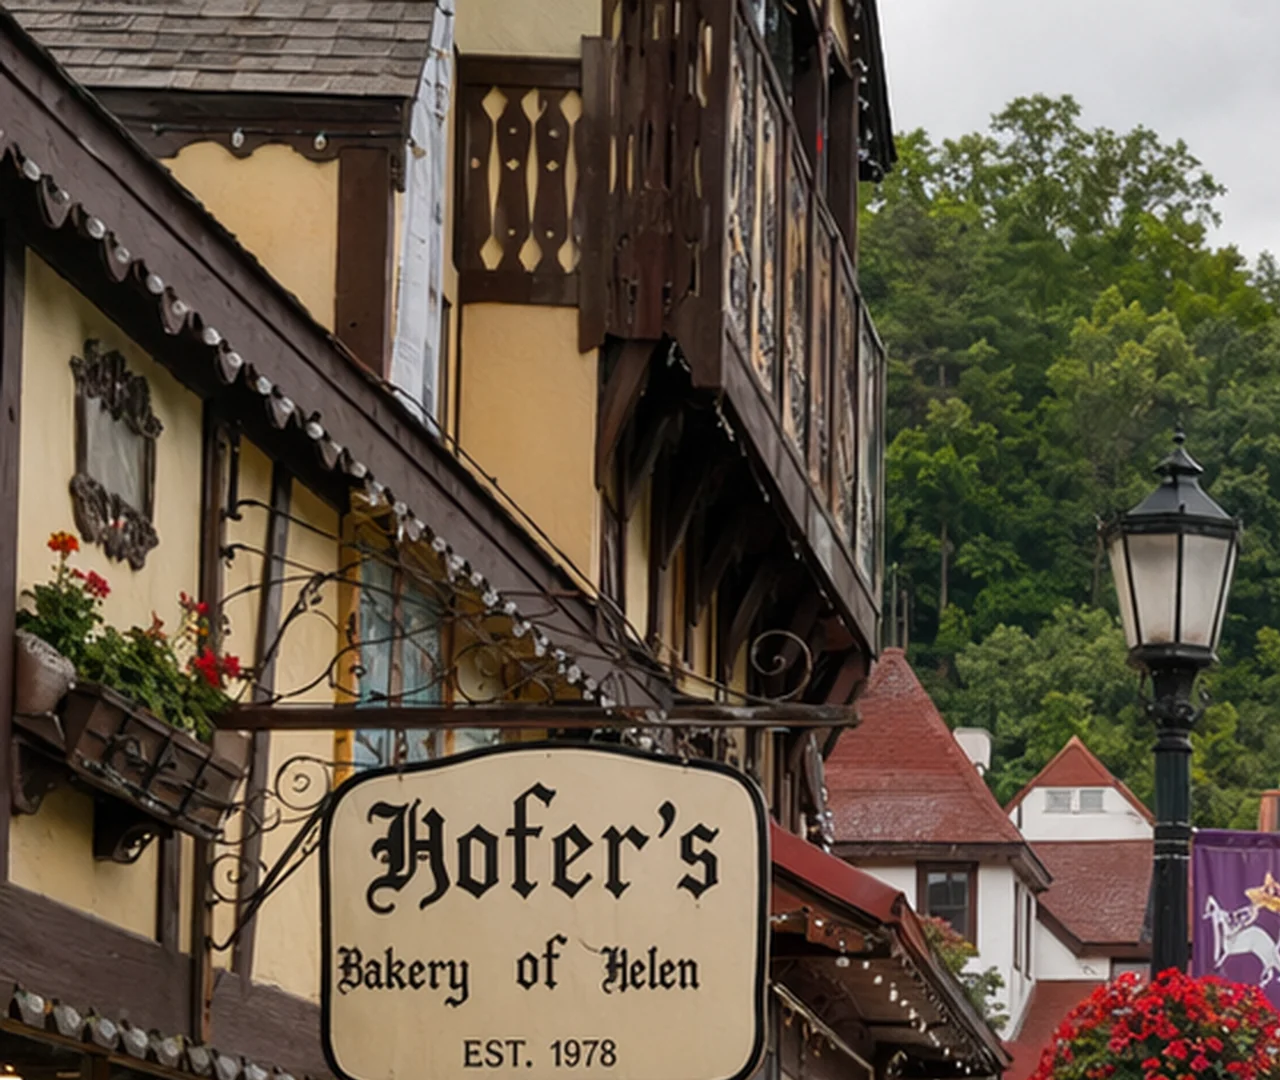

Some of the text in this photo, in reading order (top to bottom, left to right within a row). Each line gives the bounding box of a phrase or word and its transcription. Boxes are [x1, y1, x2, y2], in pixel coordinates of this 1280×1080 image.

[365, 782, 720, 915] Hofer's
[336, 933, 700, 1009] Bakery of Helen
[463, 1038, 617, 1069] EST. 1978
